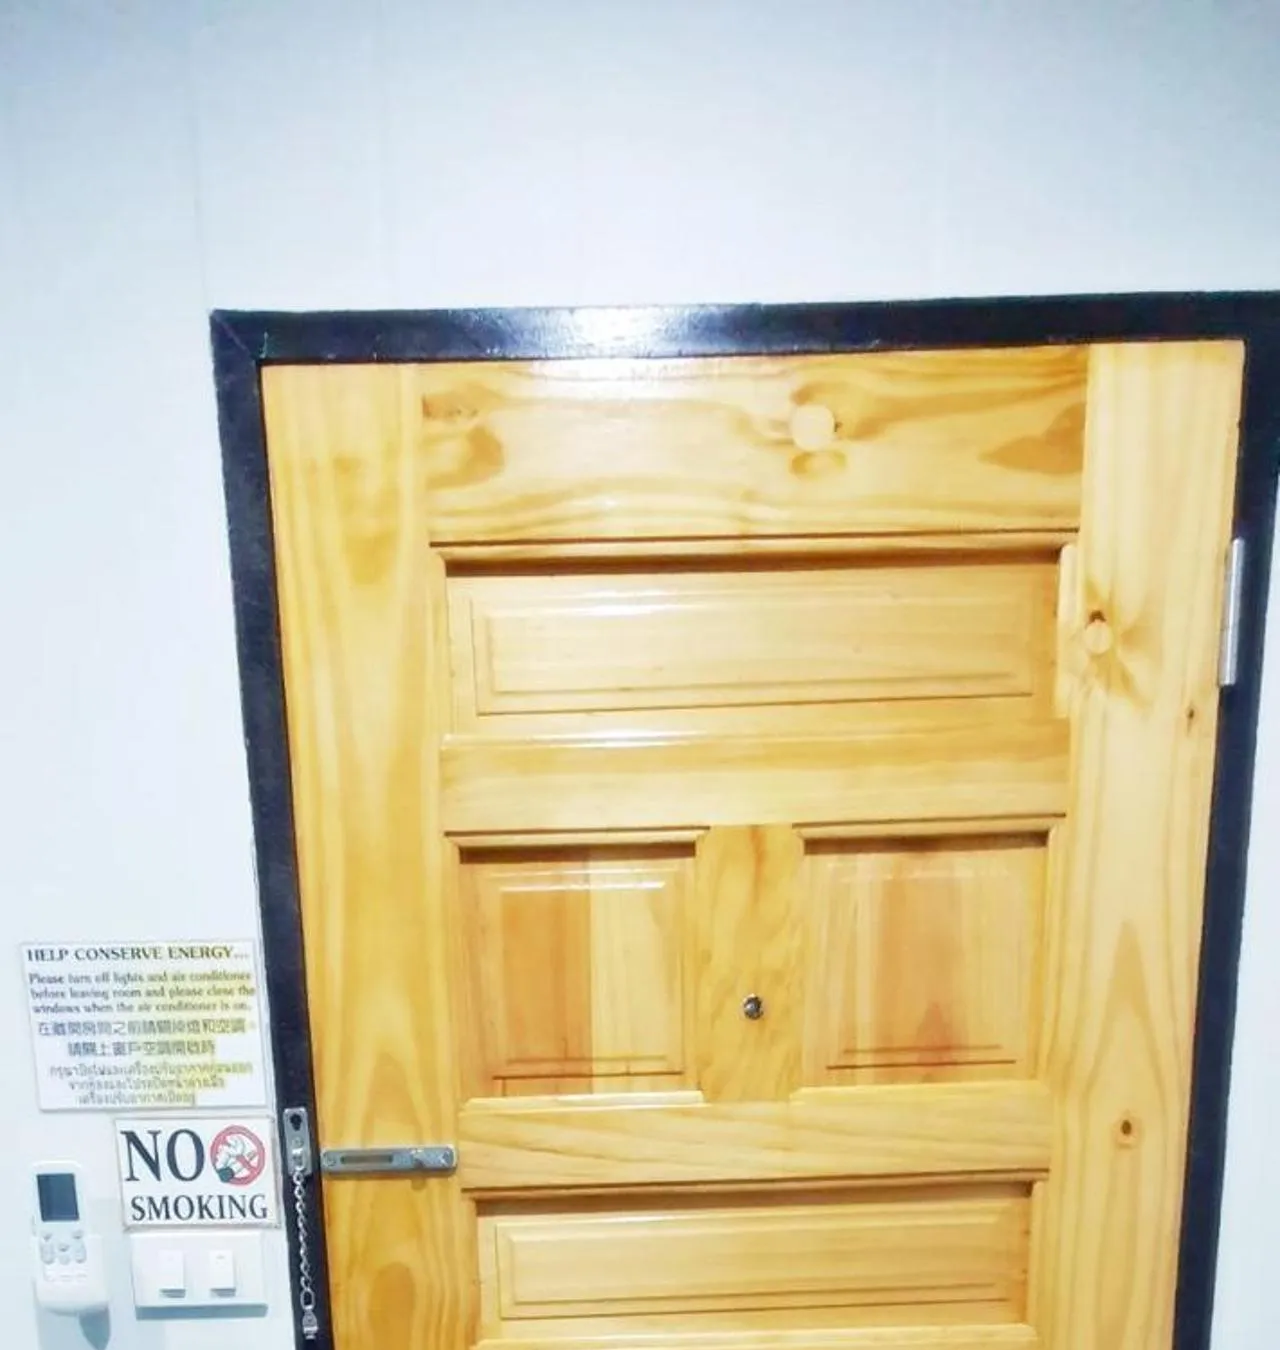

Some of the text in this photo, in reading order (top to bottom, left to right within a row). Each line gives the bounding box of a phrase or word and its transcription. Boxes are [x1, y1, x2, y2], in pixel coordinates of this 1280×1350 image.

[27, 949, 69, 962] HELP
[74, 948, 161, 961] CONSERVE
[29, 970, 251, 985] Please turn off lights and air conditioner
[31, 985, 256, 1000] before leaving room and please close the
[33, 1003, 80, 1013] windows
[84, 1003, 113, 1013] when
[117, 1002, 134, 1012] the
[138, 1002, 152, 1012] air
[155, 1001, 217, 1012] conditioner
[221, 1000, 230, 1011] is
[120, 1129, 205, 1182] NO
[131, 1194, 268, 1221] SMOKING
